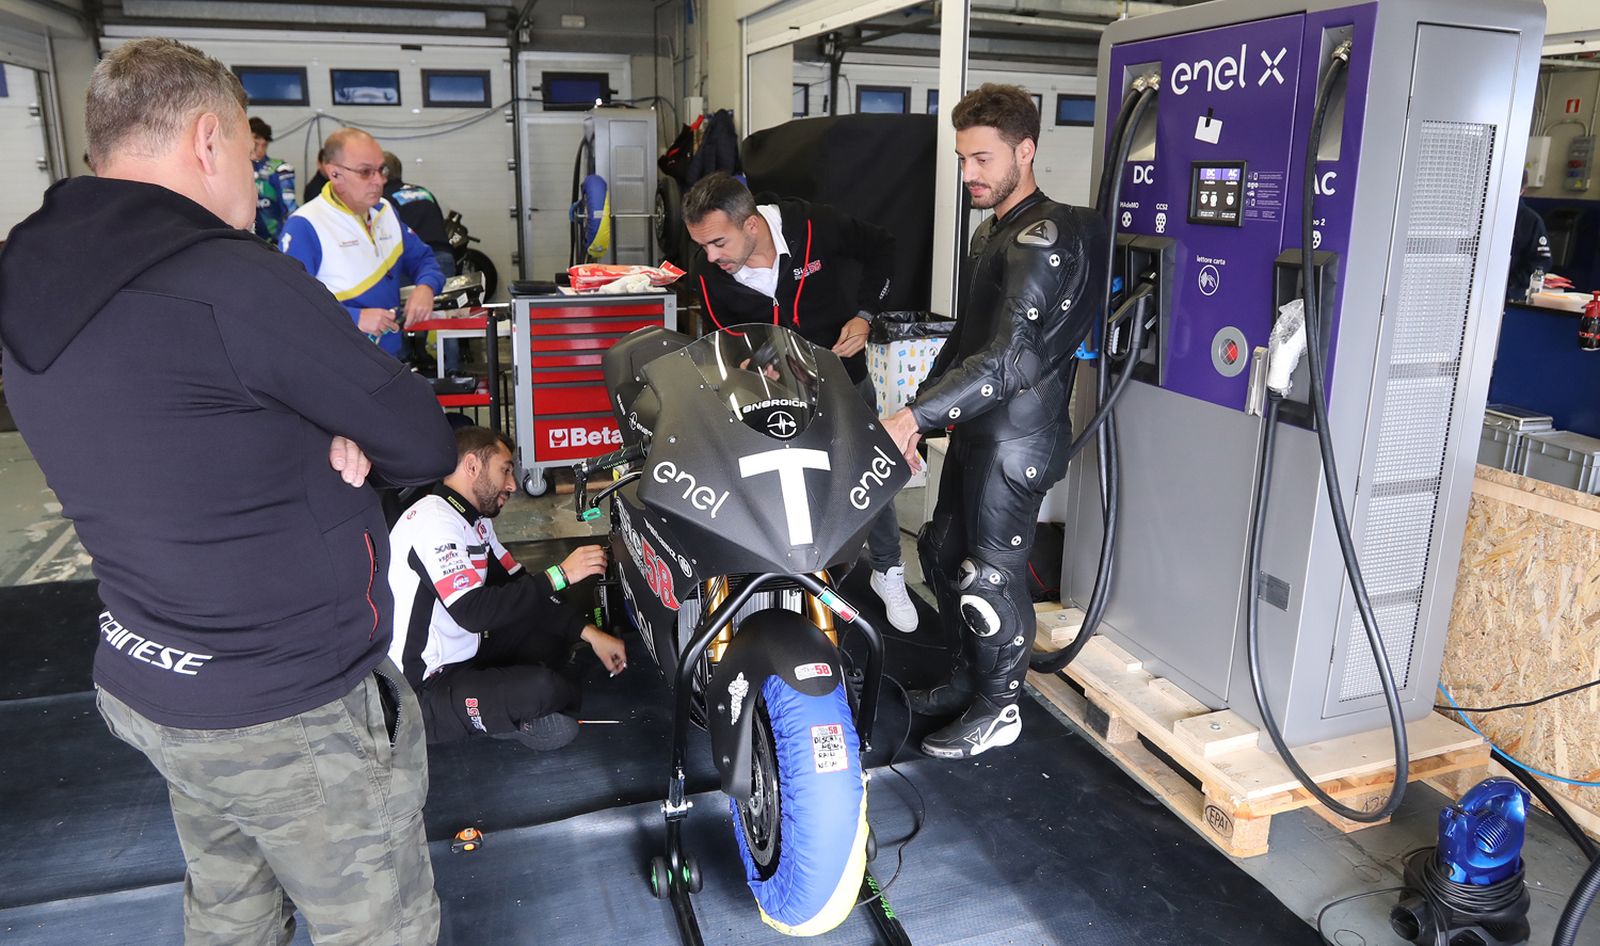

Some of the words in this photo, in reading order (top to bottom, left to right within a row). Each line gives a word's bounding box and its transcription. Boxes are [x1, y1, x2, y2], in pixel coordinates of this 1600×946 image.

[1171, 44, 1247, 95] enel
[1258, 47, 1287, 86] X
[1133, 165, 1154, 184] DC
[1206, 169, 1216, 177] DC
[571, 426, 624, 447] Beta
[850, 445, 897, 511] enel
[653, 461, 730, 519] enel
[738, 448, 831, 547] T
[815, 664, 831, 675] 58
[828, 726, 839, 735] 58
